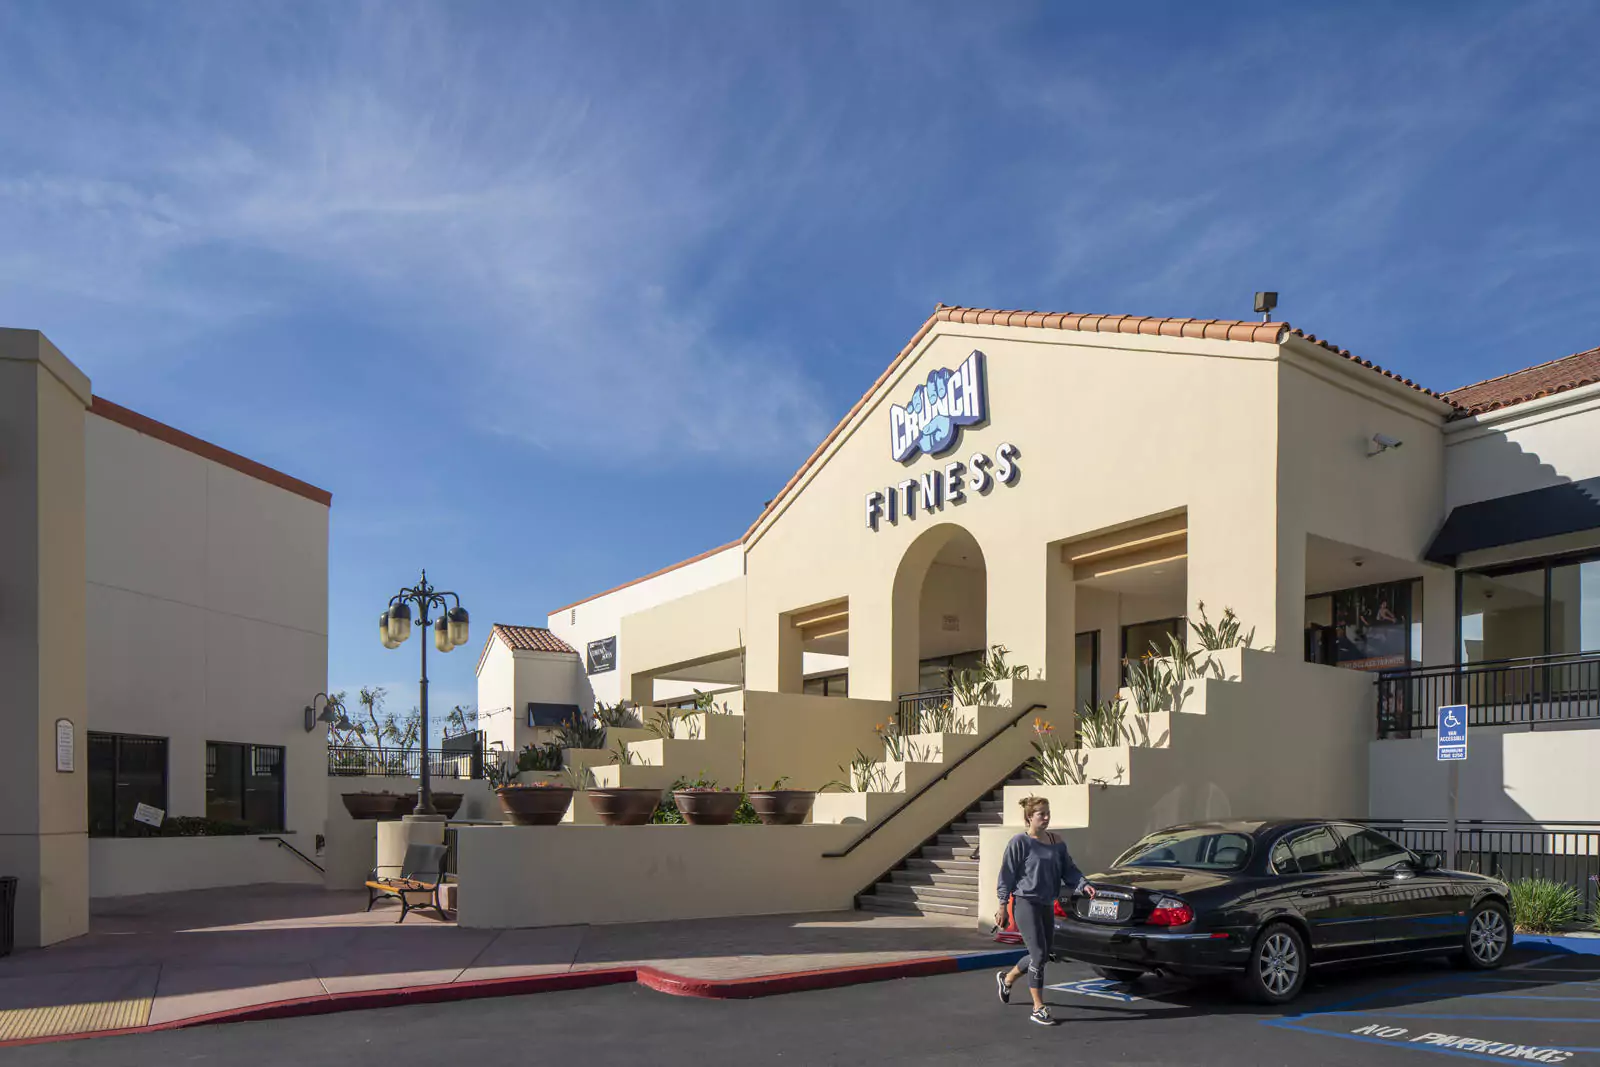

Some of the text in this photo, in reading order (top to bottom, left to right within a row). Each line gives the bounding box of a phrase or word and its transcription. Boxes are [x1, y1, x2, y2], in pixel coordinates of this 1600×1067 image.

[890, 351, 980, 461] CRUNCH
[865, 443, 1016, 529] FITNESS
[1352, 1024, 1574, 1063] NO PARKING
